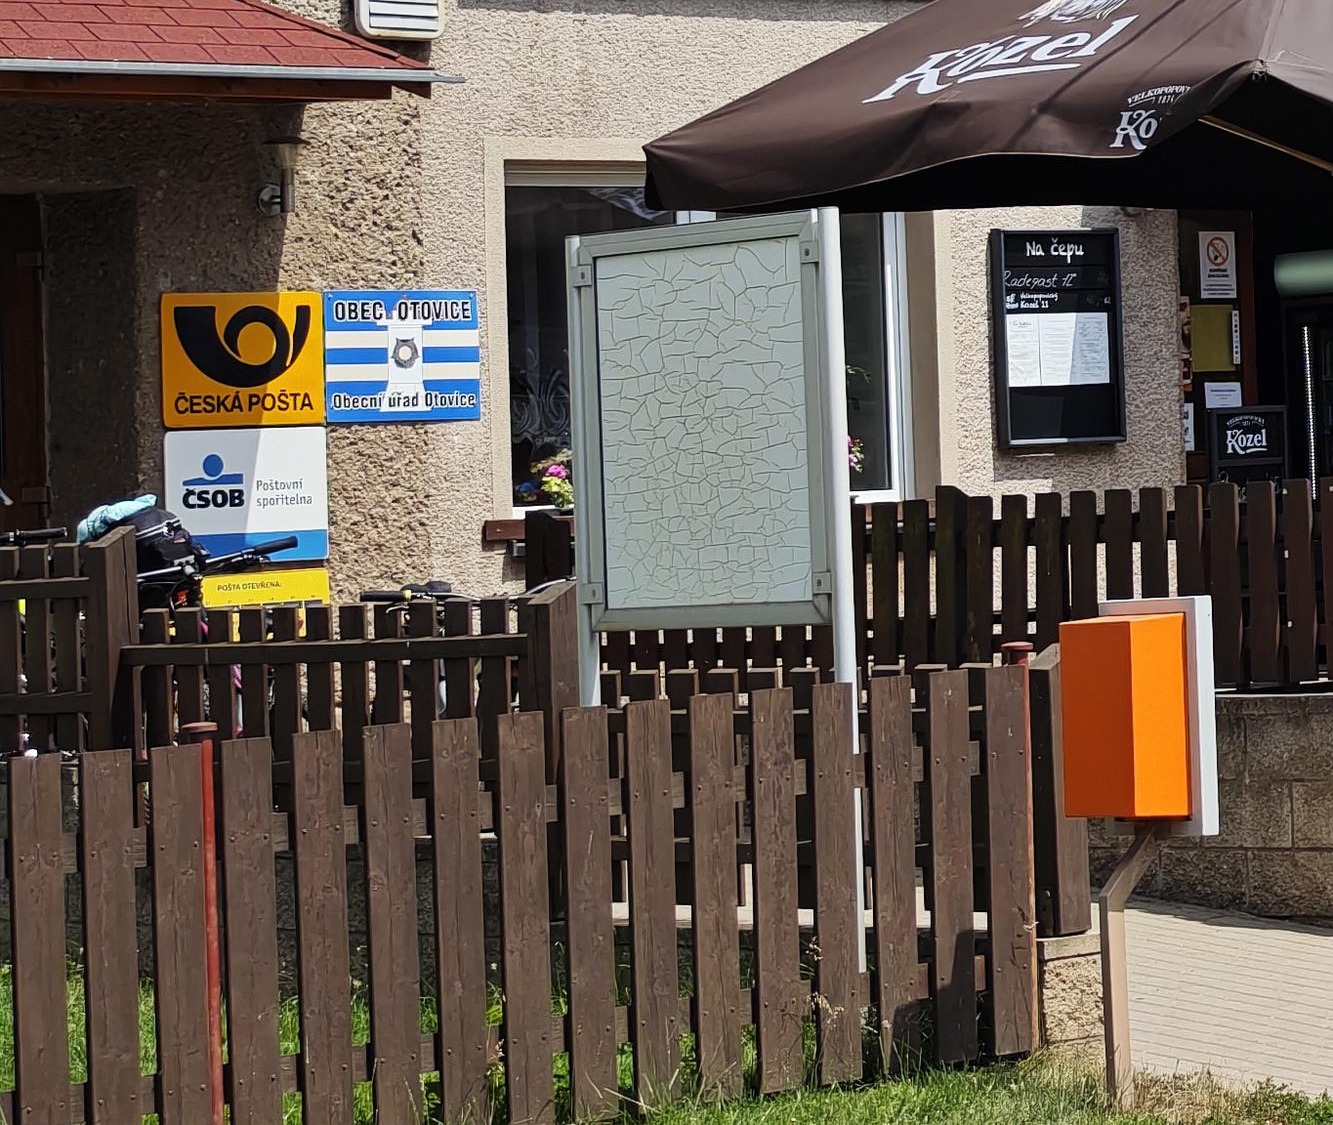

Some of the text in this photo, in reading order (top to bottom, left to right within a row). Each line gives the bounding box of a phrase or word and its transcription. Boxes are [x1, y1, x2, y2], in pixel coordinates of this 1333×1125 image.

[862, 14, 1140, 103] Kozel
[1026, 237, 1085, 264] Na čepu
[334, 300, 472, 321] OBEC OTOVICE
[174, 389, 314, 414] ČESKÁ POŠTA
[333, 392, 385, 408] Obecní
[425, 391, 476, 407] Otovice
[1226, 428, 1268, 455] Kozel
[256, 478, 303, 491] Poštovní
[182, 488, 245, 509] ČSOB
[256, 493, 313, 510] spořitelna
